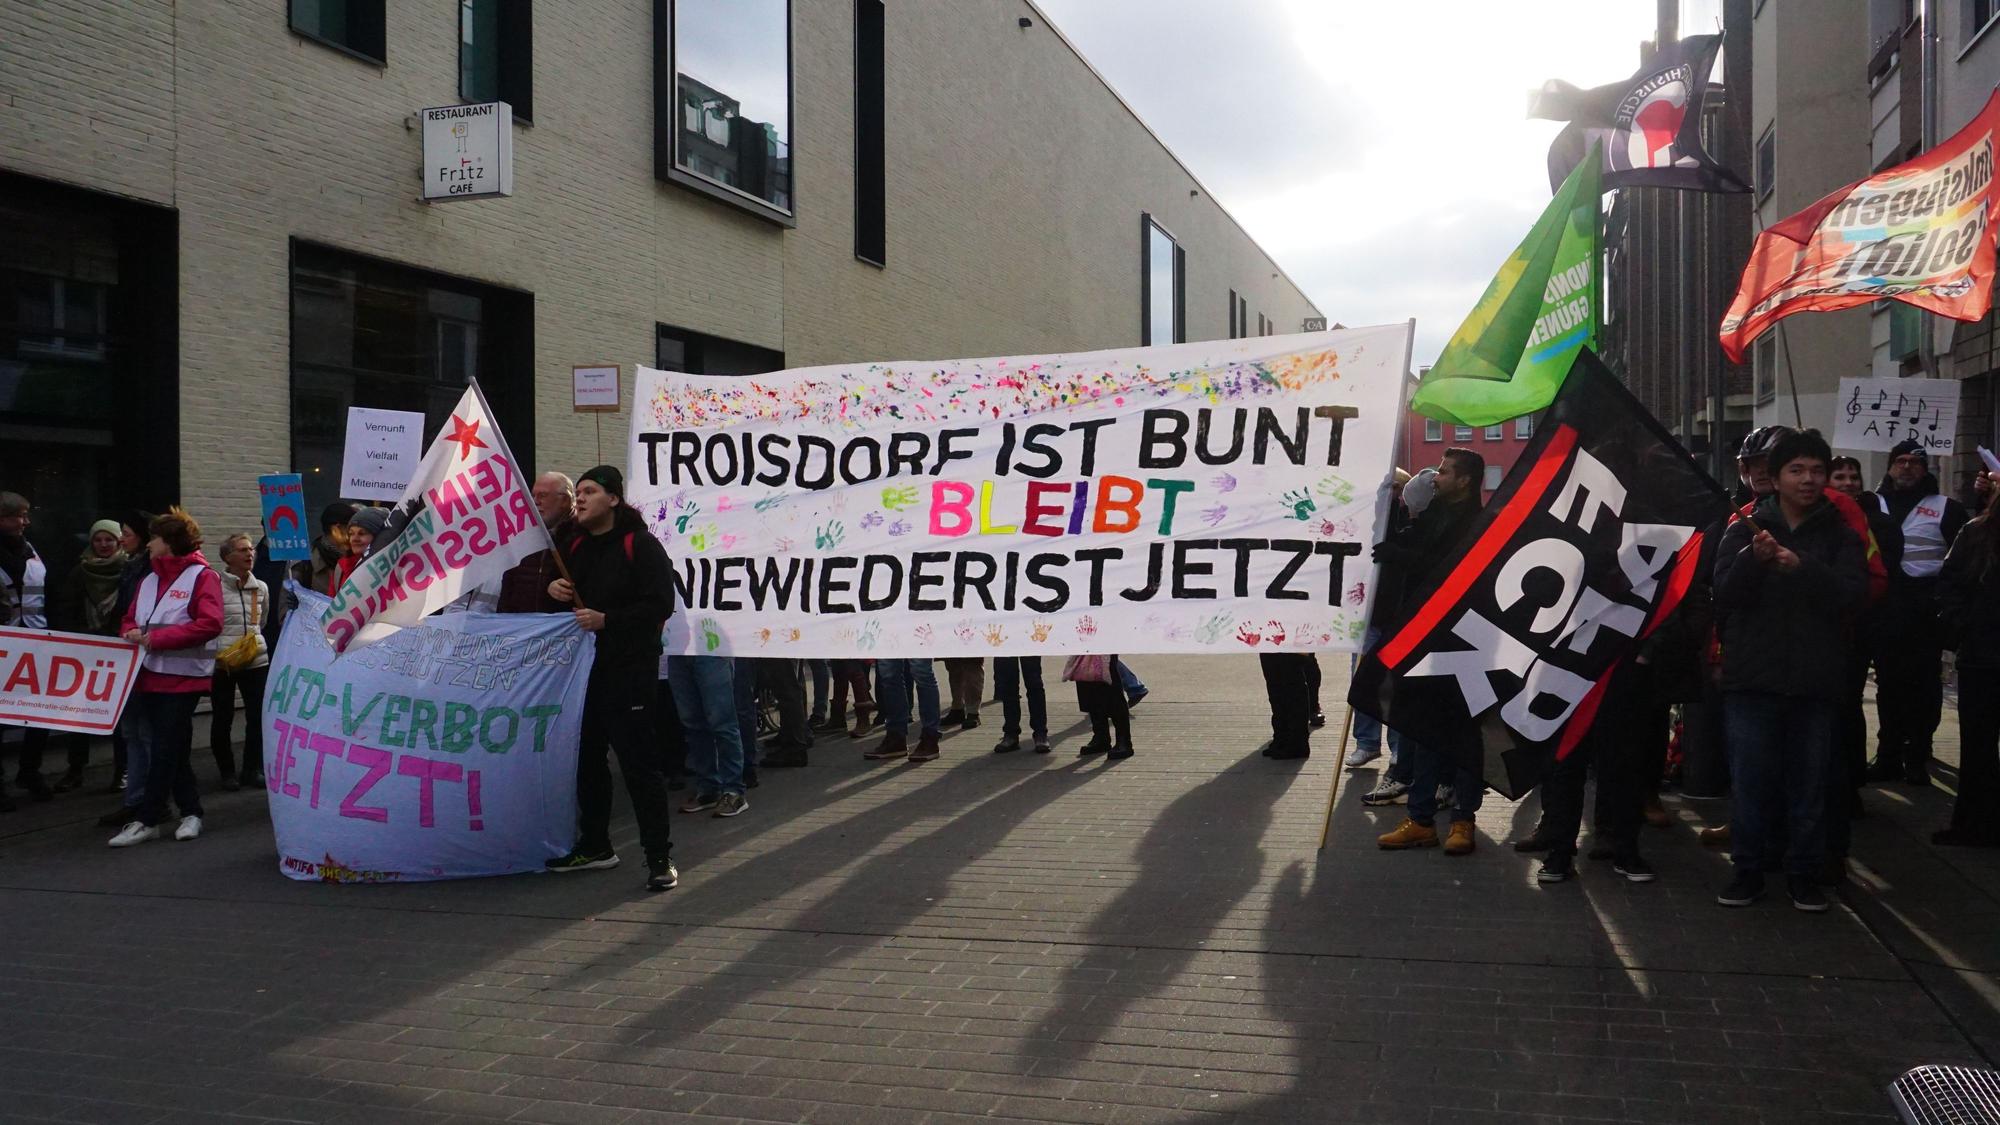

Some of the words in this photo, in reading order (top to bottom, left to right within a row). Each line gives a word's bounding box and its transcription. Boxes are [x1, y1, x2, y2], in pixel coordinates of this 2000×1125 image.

[428, 104, 494, 120] RESTAURANT
[440, 165, 484, 181] Fritz
[449, 182, 473, 194] CAFÉ
[365, 422, 405, 433] Vernunft
[638, 428, 980, 491] TROISDORF
[995, 417, 1117, 478] IST
[1138, 405, 1360, 469] BUNT
[1923, 434, 1952, 449] Nee
[366, 450, 399, 461] Vielfalt
[259, 482, 302, 497] Gegen
[350, 478, 408, 491] Miteinander
[928, 474, 1195, 537] BLEIBT
[269, 535, 308, 549] Nazis
[267, 664, 563, 754] AFD-VERBOT
[268, 718, 485, 832] JETZT!
